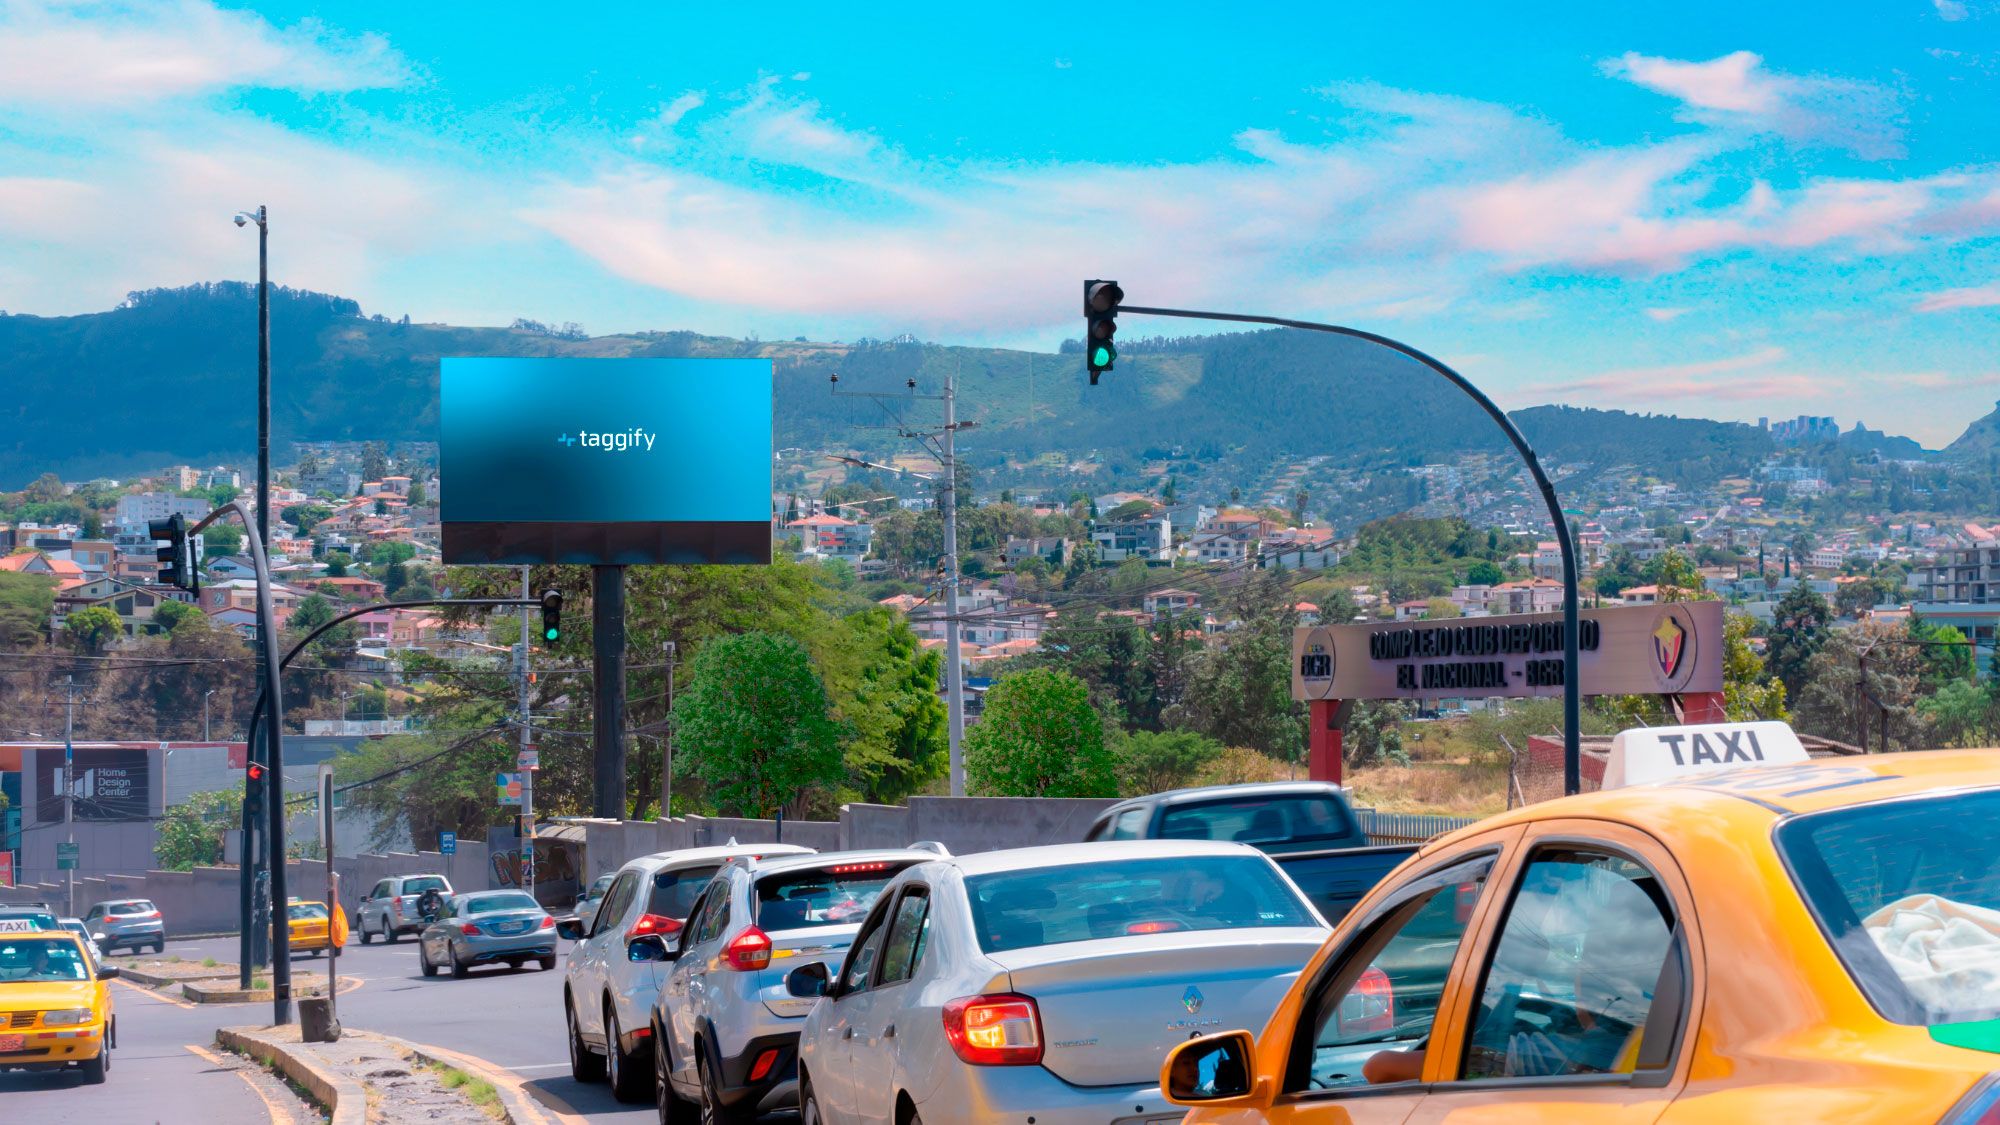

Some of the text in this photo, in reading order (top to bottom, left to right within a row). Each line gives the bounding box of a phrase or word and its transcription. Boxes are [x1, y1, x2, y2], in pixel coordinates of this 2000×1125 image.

[579, 427, 656, 452] taggify
[1369, 619, 1600, 660] COMPLEJO CLUB DEPORTO
[1396, 664, 1418, 689] EL
[1421, 660, 1508, 689] NACIONAL
[1525, 658, 1565, 687] BGR
[1657, 730, 1765, 766] TAXI
[97, 768, 127, 777] Home
[97, 777, 131, 788] Design
[97, 787, 130, 796] Center
[0, 922, 28, 932] TAXI
